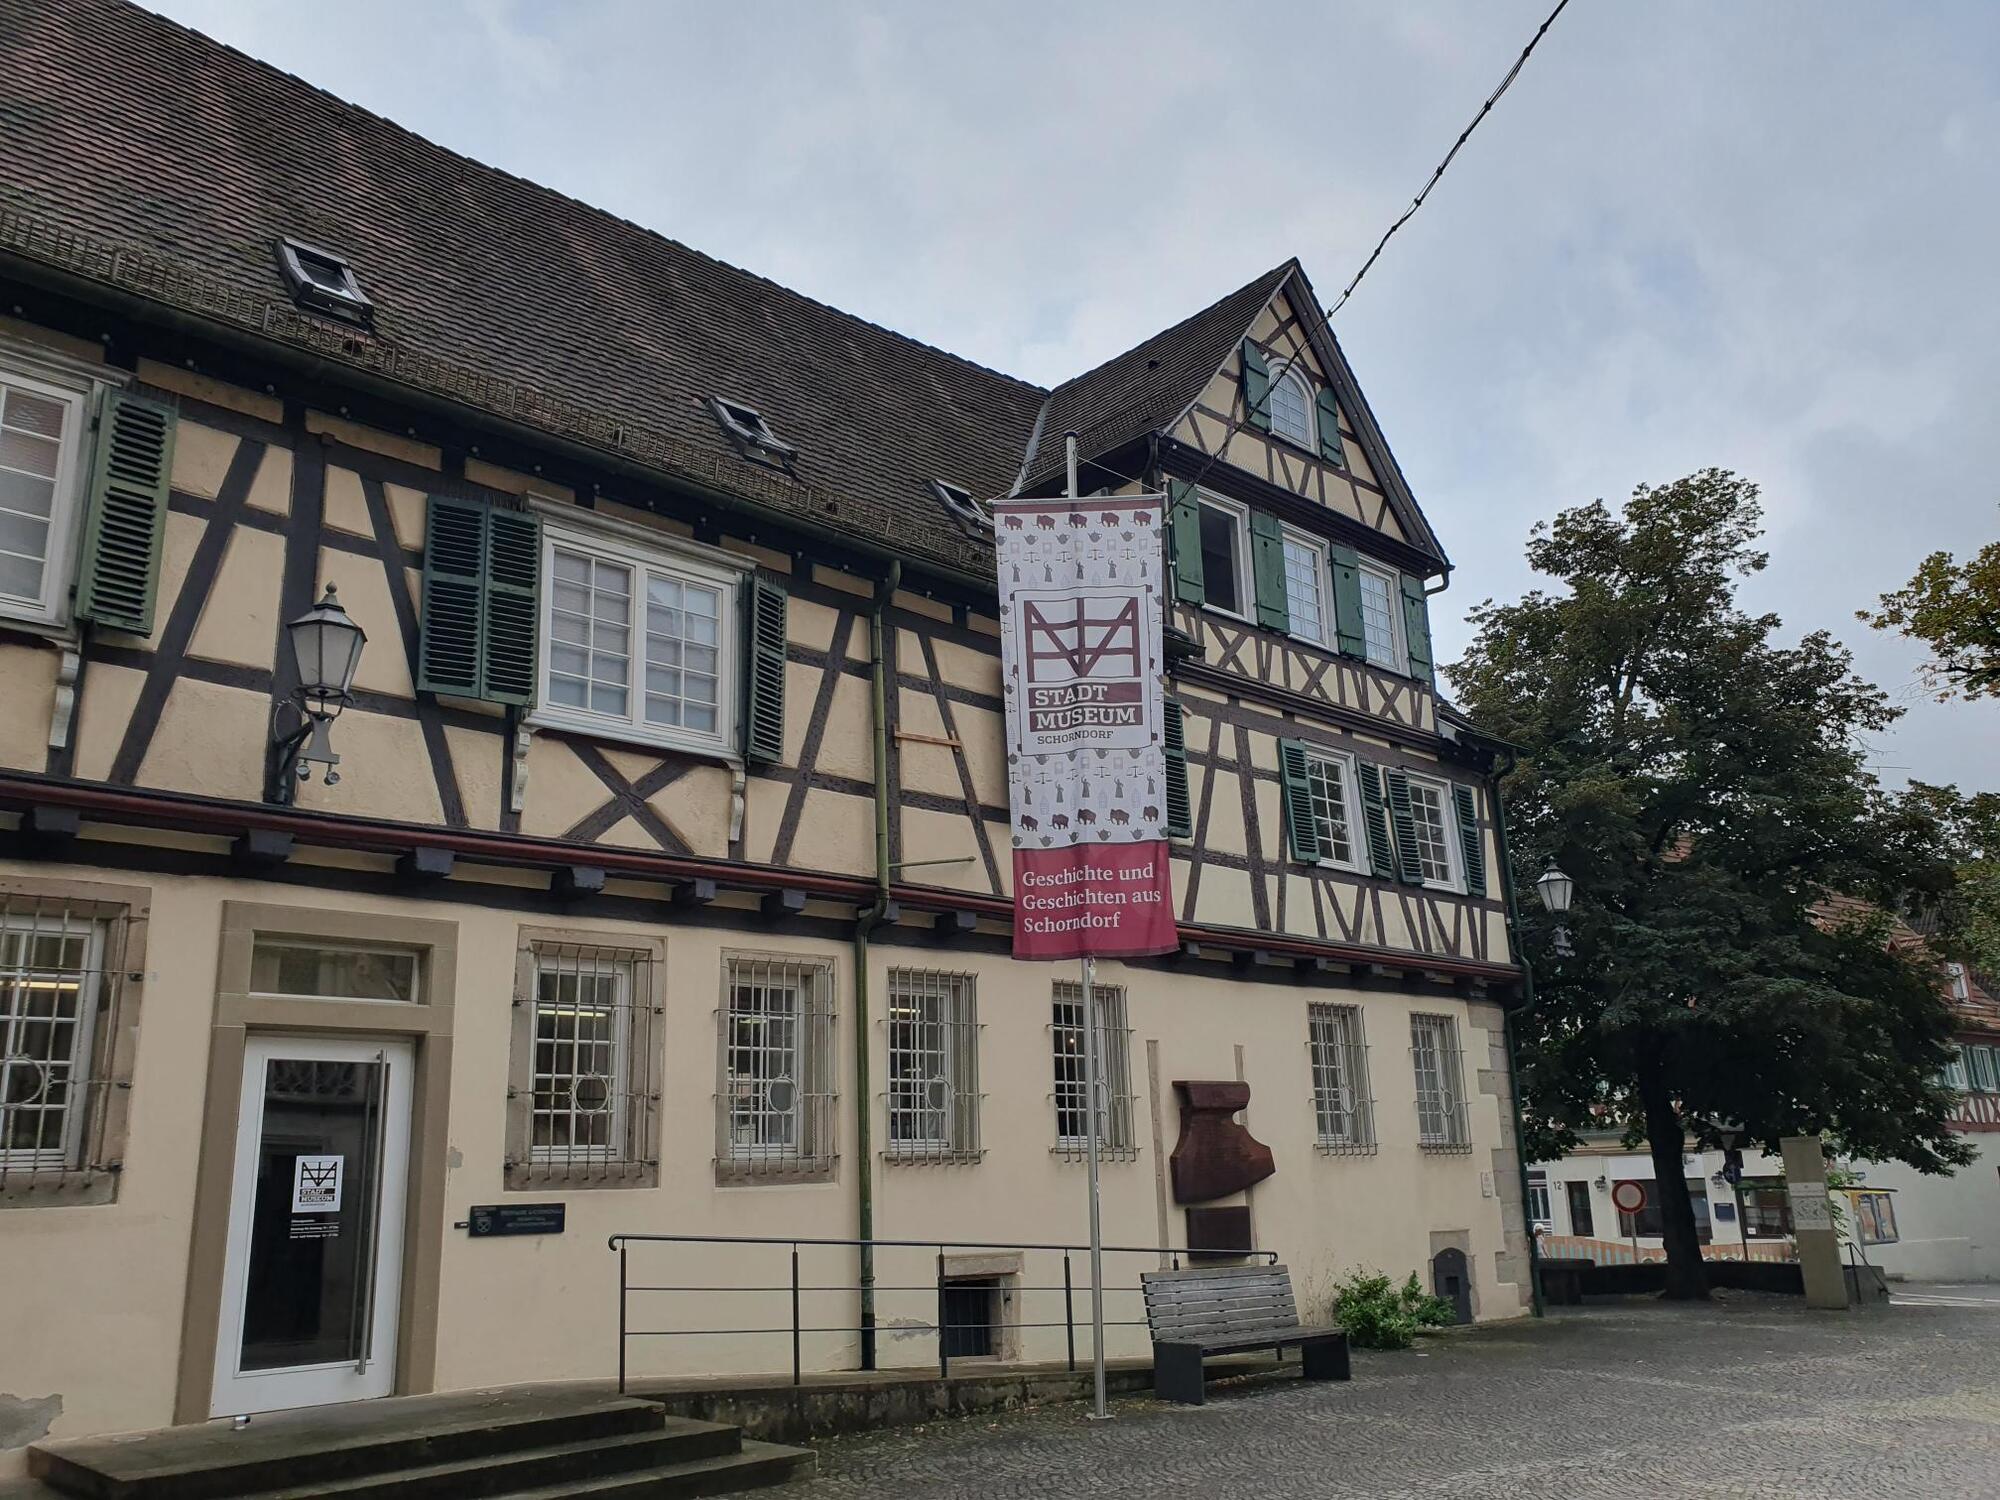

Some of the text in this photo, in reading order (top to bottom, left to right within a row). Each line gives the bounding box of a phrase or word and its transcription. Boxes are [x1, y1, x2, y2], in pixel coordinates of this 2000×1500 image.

[1035, 685, 1108, 706] STADT
[1036, 707, 1136, 729] MUSEUM
[1037, 730, 1114, 745] SCHORNDORF
[1022, 862, 1154, 887] Geschichte und
[1022, 888, 1161, 910] Geschichten aus
[1023, 911, 1121, 933] Schorndorf
[1553, 1181, 1563, 1191] 12
